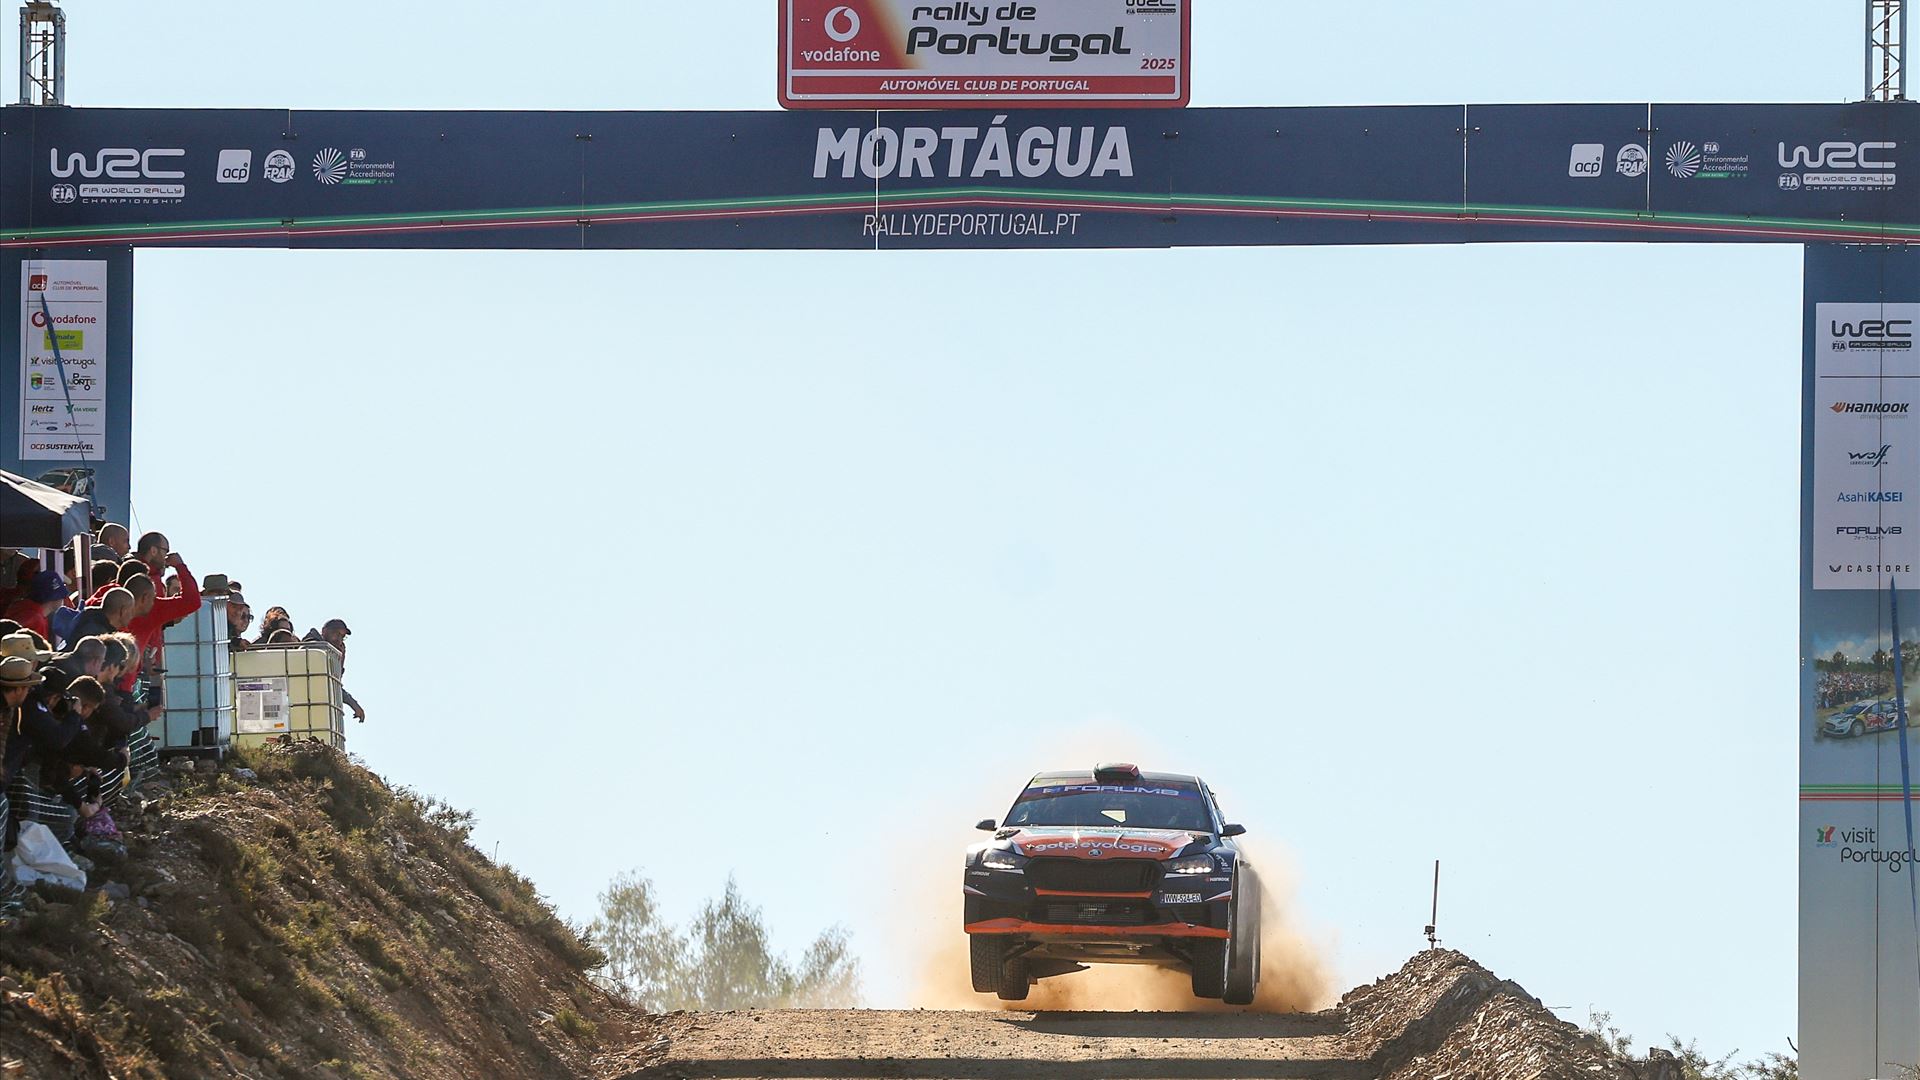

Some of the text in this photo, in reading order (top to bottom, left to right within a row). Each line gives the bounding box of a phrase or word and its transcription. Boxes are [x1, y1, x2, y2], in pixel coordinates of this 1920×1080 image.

[912, 2, 1036, 25] rally de
[906, 27, 1130, 62] Portugal
[803, 48, 880, 62] vodafone
[1141, 58, 1176, 70] 2025
[880, 77, 1089, 91] AUTOMÓVEL CLUB DE PORTUGAL
[813, 114, 1134, 179] MORTÁGUA
[1704, 144, 1718, 153] FIA
[351, 150, 365, 159] FIA
[1703, 155, 1749, 163] Environmental
[1778, 141, 1896, 168] WRC
[50, 147, 186, 179] WRC
[350, 161, 395, 170] Environmental
[1574, 162, 1600, 175] acp
[1616, 160, 1647, 173] FPAK
[1703, 163, 1748, 172] Accreditation
[222, 168, 248, 181] acp
[263, 167, 295, 180] FPAK
[349, 170, 395, 178] Accreditation
[1779, 176, 1799, 187] FIA
[53, 187, 75, 200] FIA
[863, 213, 1081, 236] RALLYDEPORTUGAL.PT
[51, 314, 97, 324] vodafone
[1832, 320, 1912, 338] WRC
[1837, 491, 1903, 502] AsahiKASEI
[1836, 526, 1902, 535] FORUM8
[1847, 565, 1911, 573] CASTORE
[1841, 827, 1876, 843] visit
[1841, 847, 1920, 873] Portugal
